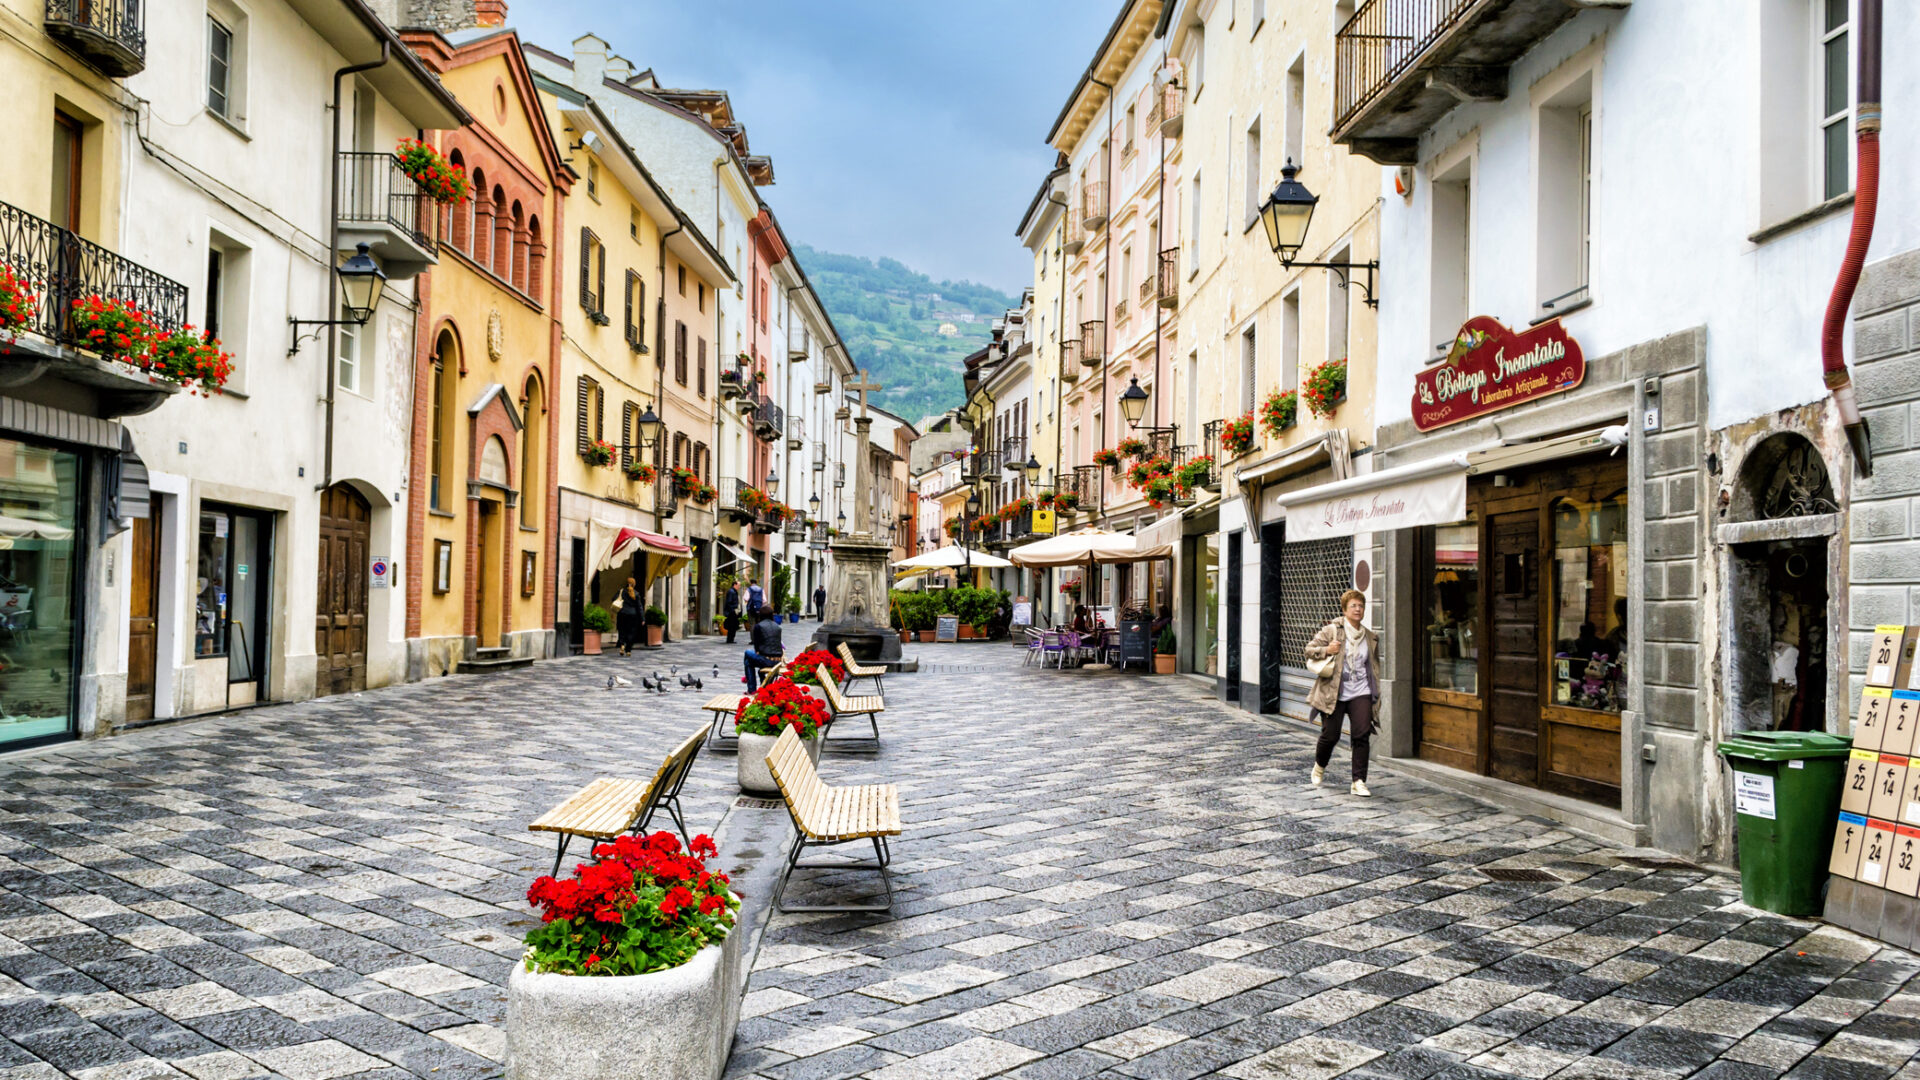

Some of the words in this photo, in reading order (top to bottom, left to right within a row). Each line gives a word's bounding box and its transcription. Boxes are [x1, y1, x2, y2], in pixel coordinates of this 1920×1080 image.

[1419, 382, 1434, 405] La
[1435, 367, 1487, 404] Bottega
[1492, 337, 1566, 383] Incantata
[1481, 384, 1513, 405] Laboratorio
[1515, 373, 1549, 394] Artigianale
[1648, 414, 1654, 425] 6
[1324, 501, 1335, 527] La
[1336, 499, 1364, 532] Bottega
[1365, 492, 1405, 519] Incantata
[1877, 648, 1891, 664] 20
[1864, 711, 1878, 727] 21
[1896, 714, 1905, 731] 2
[1852, 774, 1866, 791] 22
[1883, 779, 1895, 796] 14
[1844, 838, 1850, 854] 1
[1868, 844, 1882, 862] 24
[1899, 852, 1913, 870] 32
